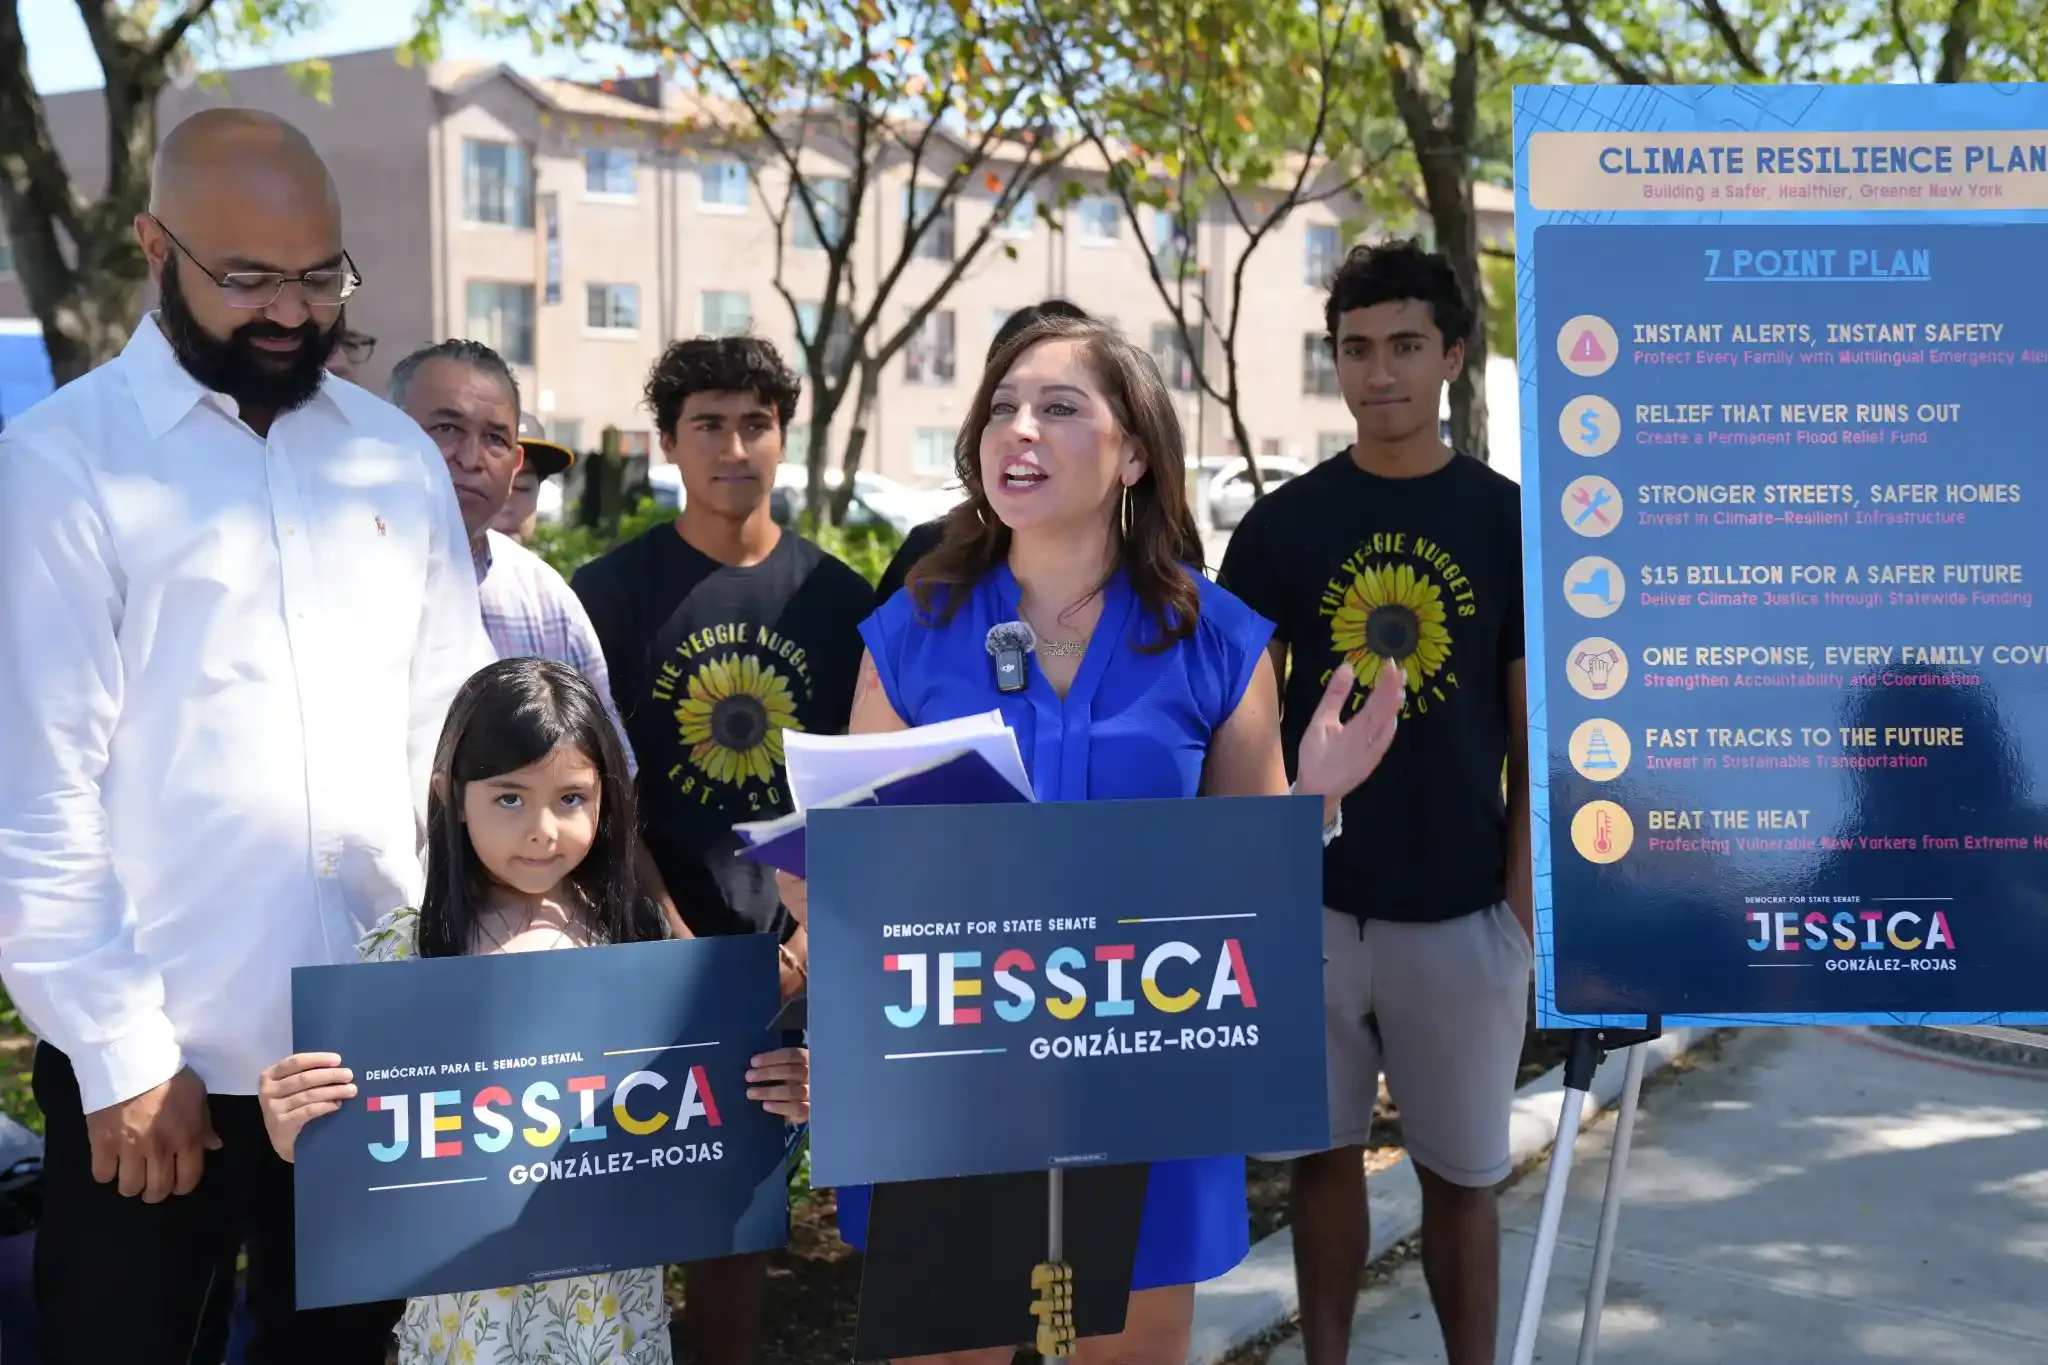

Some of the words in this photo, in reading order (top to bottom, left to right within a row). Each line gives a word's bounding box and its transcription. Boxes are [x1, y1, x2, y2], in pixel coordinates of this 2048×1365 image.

[1599, 146, 1744, 175] CLIMATE
[1756, 145, 1952, 174] RESILIENCE
[1965, 145, 2047, 172] PLAN
[1643, 184, 1705, 202] Building
[1710, 187, 1721, 198] a
[1725, 184, 1771, 201] Safer,
[1779, 184, 1852, 200] Healthier,
[1860, 184, 1923, 199] Greener
[1968, 183, 2003, 197] York
[1704, 250, 1721, 276] 7
[1734, 249, 1838, 276] POINT
[1849, 249, 1930, 276] PLAN
[1634, 324, 1723, 343] INSTANT
[1732, 324, 1817, 347] ALERTS,
[1827, 324, 1916, 342] INSTANT
[1924, 324, 2003, 342] SAFETY
[1634, 350, 1691, 365] Protect
[1696, 350, 1738, 367] Every
[1744, 349, 1794, 367] Family
[1800, 349, 1833, 365] with
[1839, 348, 1923, 367] Multilingual
[1929, 348, 2015, 366] Emergency
[2021, 348, 2048, 364] Ale
[1636, 404, 1713, 424] RELIEF
[1721, 404, 1772, 423] THAT
[1780, 404, 1849, 423] NEVER
[1857, 404, 1910, 422] RUNS
[1917, 404, 1961, 422] OUT
[1636, 431, 1689, 445] Create
[1694, 434, 1702, 444] a
[1708, 430, 1792, 445] Permanent
[1797, 430, 1837, 444] Flood
[1842, 429, 1885, 444] Relief
[1890, 429, 1928, 443] Fund
[1638, 485, 1756, 505] STRONGER
[1764, 484, 1860, 508] STREETS,
[1870, 484, 1938, 504] SAFER
[1946, 484, 2021, 503] HOMES
[1638, 511, 1689, 525] Invest
[1694, 511, 1708, 525] in
[1855, 510, 1965, 525] Infrastructure
[1319, 577, 1348, 616] THE
[1413, 537, 1475, 616] NUGGETS
[1640, 565, 1679, 586] $15
[1687, 566, 1783, 585] BILLION
[1790, 565, 1837, 585] FOR
[1844, 565, 1859, 584] A
[1867, 565, 1936, 584] SAFER
[1943, 565, 2022, 584] FUTURE
[1641, 591, 1691, 606] Deliver
[1697, 591, 1758, 606] Climate
[1763, 591, 1818, 606] Justice
[1824, 591, 1883, 608] through
[1888, 591, 1967, 606] Statewide
[1972, 591, 2032, 608] Funding
[652, 660, 683, 700] THE
[676, 623, 748, 658] VEGGIE
[1643, 647, 1688, 666] ONE
[1695, 647, 1815, 670] RESPONSE,
[1825, 646, 1893, 665] EVERY
[1901, 645, 1984, 665] FAMILY
[1992, 645, 2048, 665] COV
[1644, 673, 1729, 690] Strengthen
[1734, 673, 1844, 689] Accountability
[1850, 673, 1878, 687] and
[1881, 672, 1980, 687] Coordination
[1646, 728, 1698, 748] FAST
[1706, 728, 1793, 747] TRACKS
[1800, 728, 1832, 747] TO
[1839, 728, 1877, 746] THE
[1885, 728, 1964, 746] FUTURE
[1646, 754, 1698, 770] Invest
[1703, 755, 1717, 769] in
[1722, 754, 1810, 769] Sustainable
[1816, 753, 1928, 768] Transportation
[1649, 810, 1703, 830] BEAT
[1711, 810, 1748, 830] THE
[1756, 810, 1810, 829] HEAT
[1649, 835, 1731, 854] Protecting
[1736, 836, 1816, 852] Vulnerable
[1858, 835, 1917, 850] Yorkers
[1922, 834, 1959, 850] from
[1964, 834, 2028, 850] Extreme
[883, 923, 962, 938] DEMOCRAT
[967, 921, 997, 934] FOR
[1003, 919, 1043, 933] STATE
[1048, 917, 1097, 931] SENATE
[1746, 911, 1955, 952] JESSICA
[1825, 956, 1956, 972] GONZÁLEZ-ROJAS
[883, 939, 1258, 1028] JESSICA
[1030, 1026, 1259, 1060] GONZÁLEZ-ROJAS
[366, 1063, 437, 1081] DEMÓCRATA
[441, 1062, 471, 1075] PARA
[475, 1061, 489, 1072] EL
[493, 1056, 537, 1071] SENADO
[541, 1052, 584, 1066] ESTATAL
[366, 1065, 722, 1163] JESSICA
[509, 1142, 724, 1185] GONZÁLEZ-ROJAS
